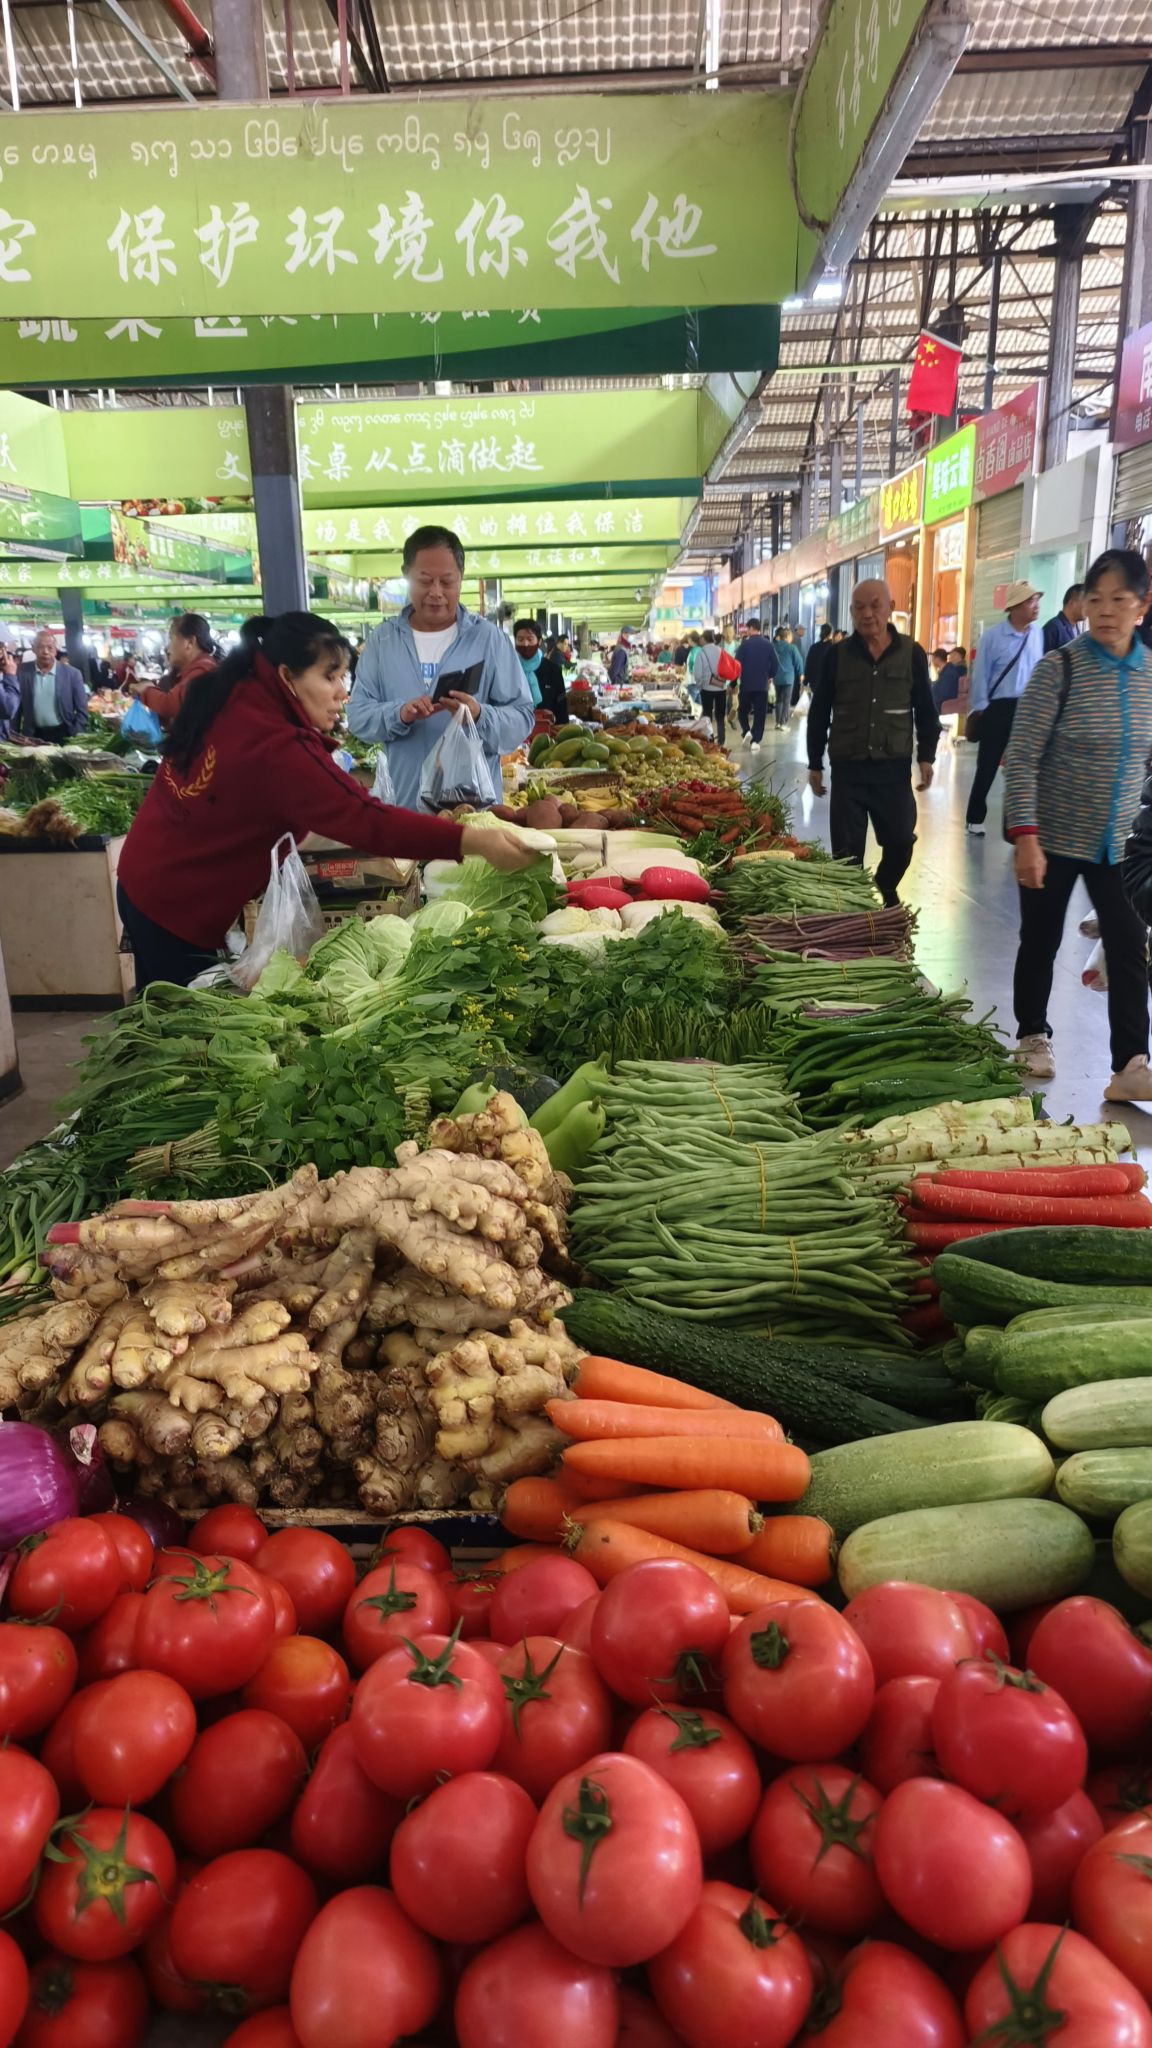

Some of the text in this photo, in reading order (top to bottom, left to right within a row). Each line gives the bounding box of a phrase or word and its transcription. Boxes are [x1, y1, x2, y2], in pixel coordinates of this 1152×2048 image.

[107, 184, 718, 288] 保护环境你我他
[364, 434, 545, 476] 从点滴做起
